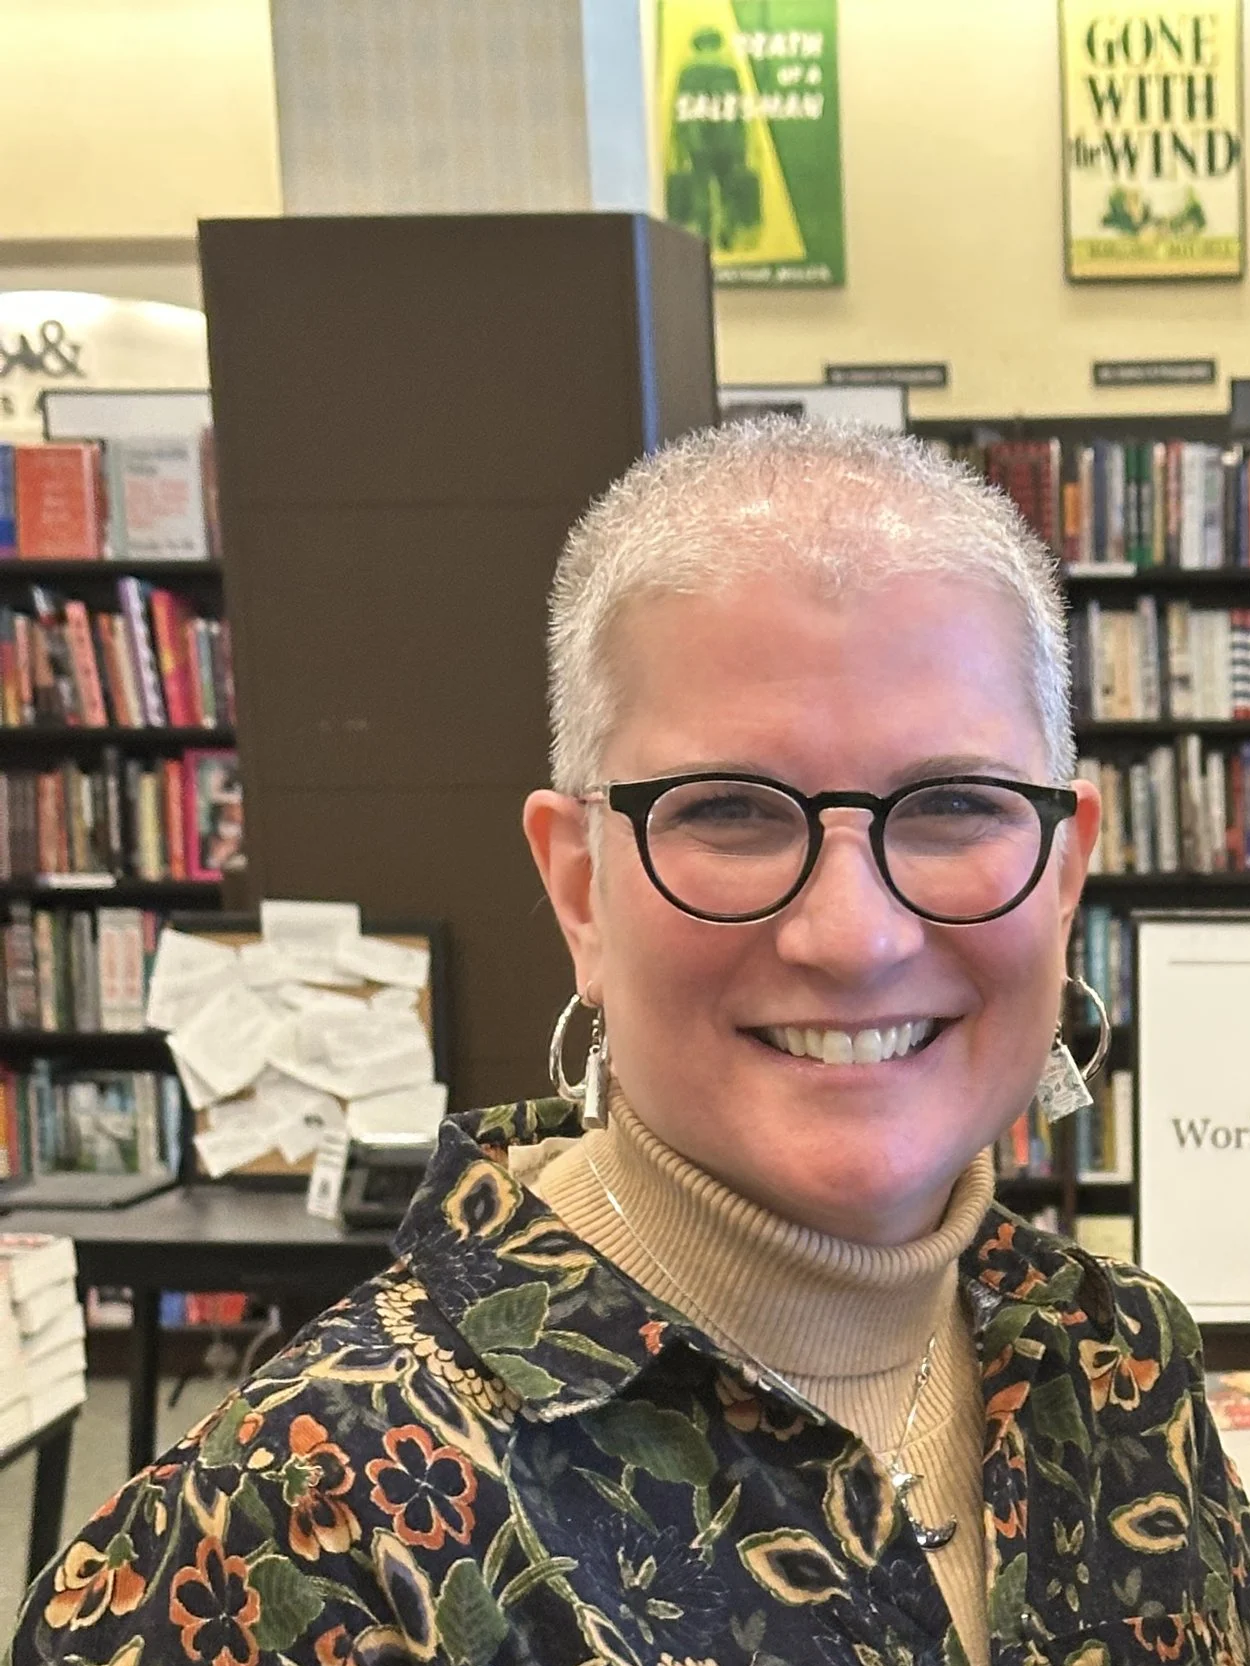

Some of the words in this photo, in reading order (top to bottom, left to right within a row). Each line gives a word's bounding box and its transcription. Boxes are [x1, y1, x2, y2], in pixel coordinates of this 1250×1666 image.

[732, 31, 823, 60] DEATH
[1085, 14, 1219, 68] GONE
[676, 92, 824, 121] SALESMAN
[1085, 72, 1219, 123] WITH
[1101, 129, 1241, 178] WIND
